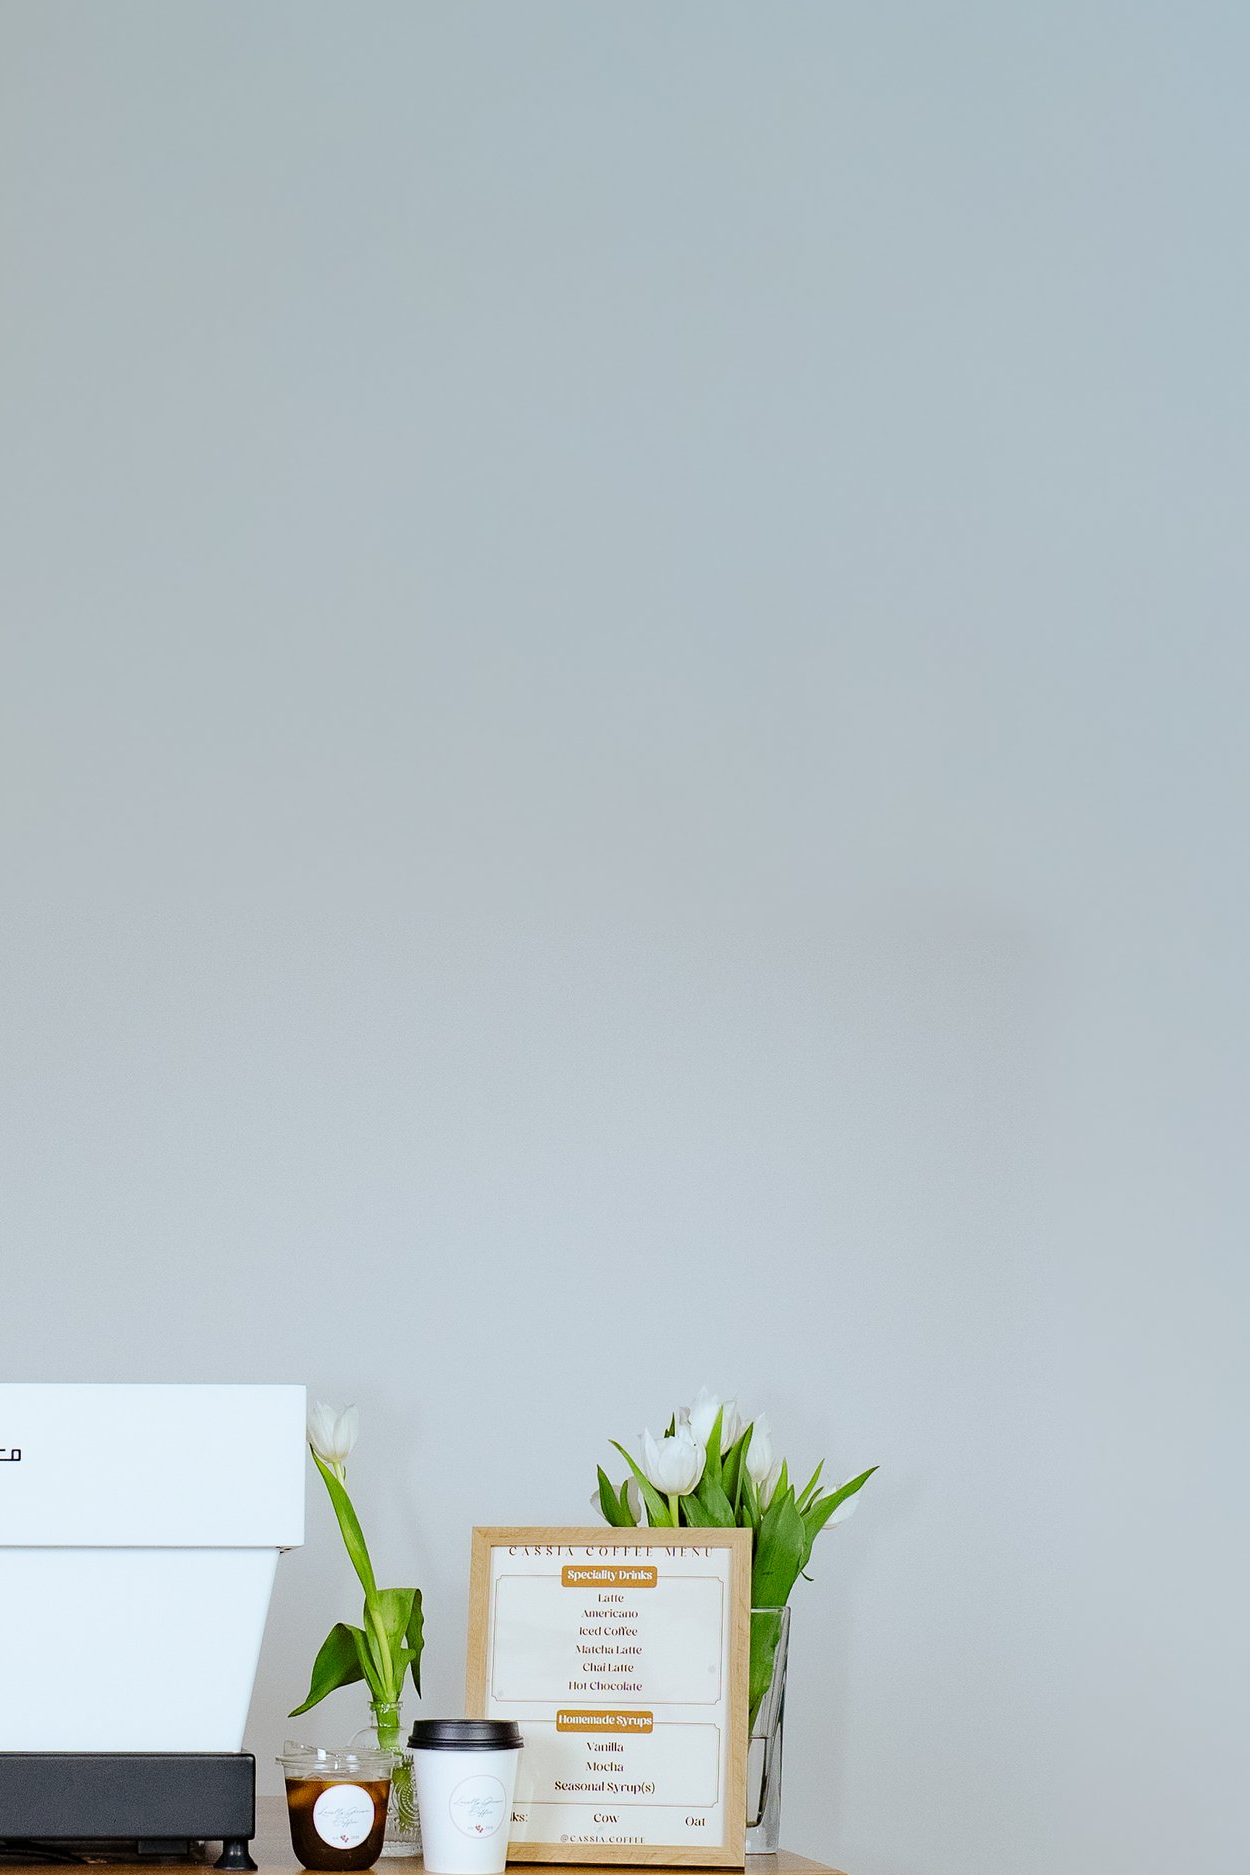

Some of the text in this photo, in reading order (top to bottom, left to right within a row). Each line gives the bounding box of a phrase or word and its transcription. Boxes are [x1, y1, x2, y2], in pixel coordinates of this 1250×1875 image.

[508, 1545, 713, 1558] CASSIA COFFEE MENU
[618, 1569, 653, 1580] Drinks
[598, 1593, 625, 1603] Latte
[581, 1608, 639, 1619] Americano
[579, 1625, 639, 1637] Iced Coffee
[575, 1644, 643, 1656] Matcha Latte
[582, 1662, 635, 1673] Chai Latte
[568, 1680, 644, 1692] Hot Chocolate
[558, 1714, 653, 1728] Homemade Syrups
[586, 1741, 624, 1753] Vanilla
[586, 1761, 624, 1773] Mocha
[554, 1780, 656, 1796] Seasonal Syrup(s)
[593, 1812, 620, 1824] Cow
[684, 1815, 706, 1827] Oat
[560, 1833, 646, 1845] @CASSIA.COFFEE
